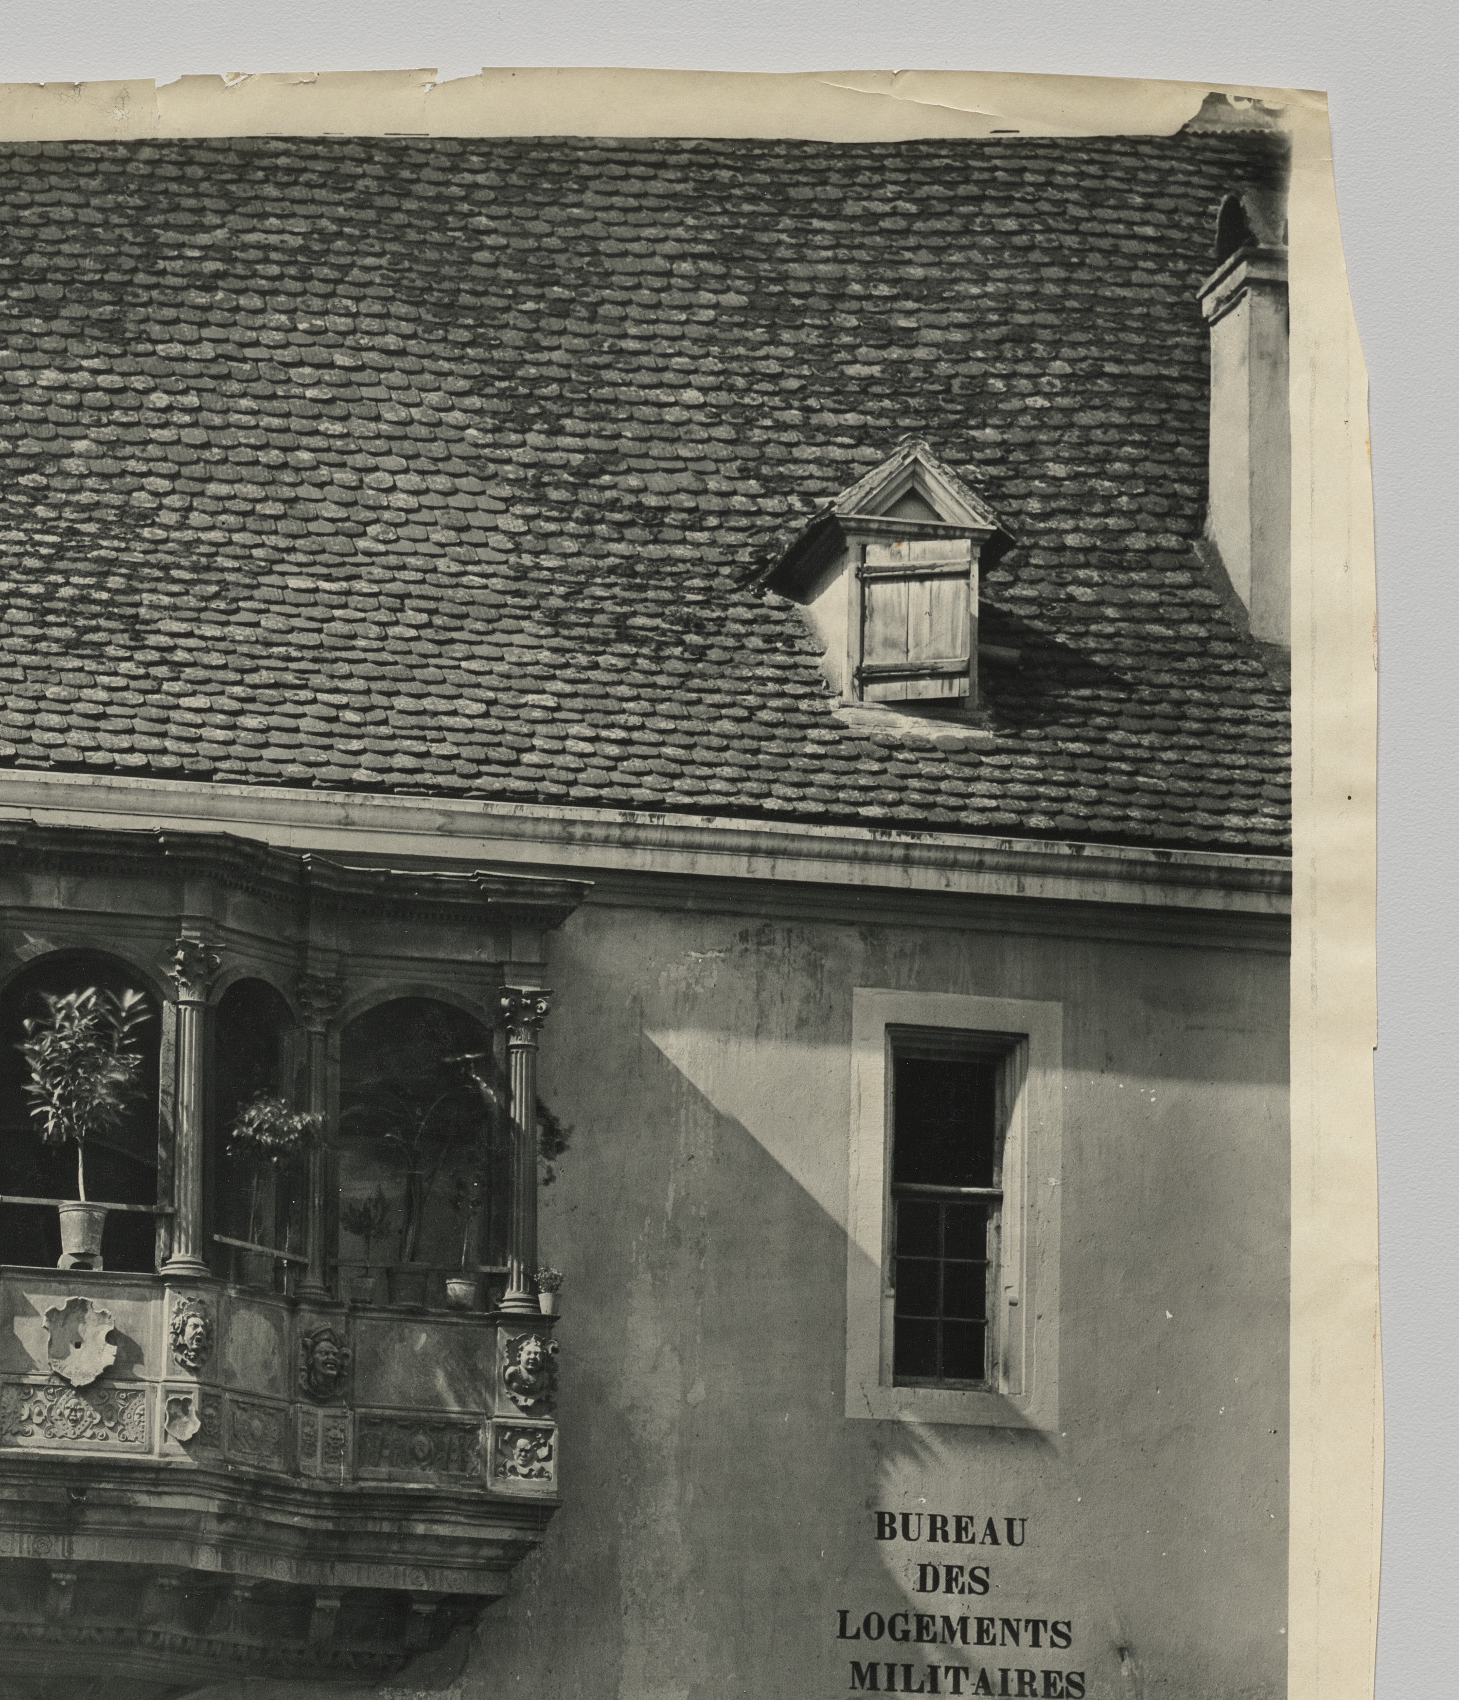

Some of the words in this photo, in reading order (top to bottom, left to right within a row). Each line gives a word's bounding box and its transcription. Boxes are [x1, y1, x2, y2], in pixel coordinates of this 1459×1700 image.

[874, 1511, 1029, 1547] BUREAU
[916, 1563, 990, 1596] DES
[836, 1610, 1072, 1649] LOGEMENTS
[849, 1661, 1086, 1700] MILITAIRES
